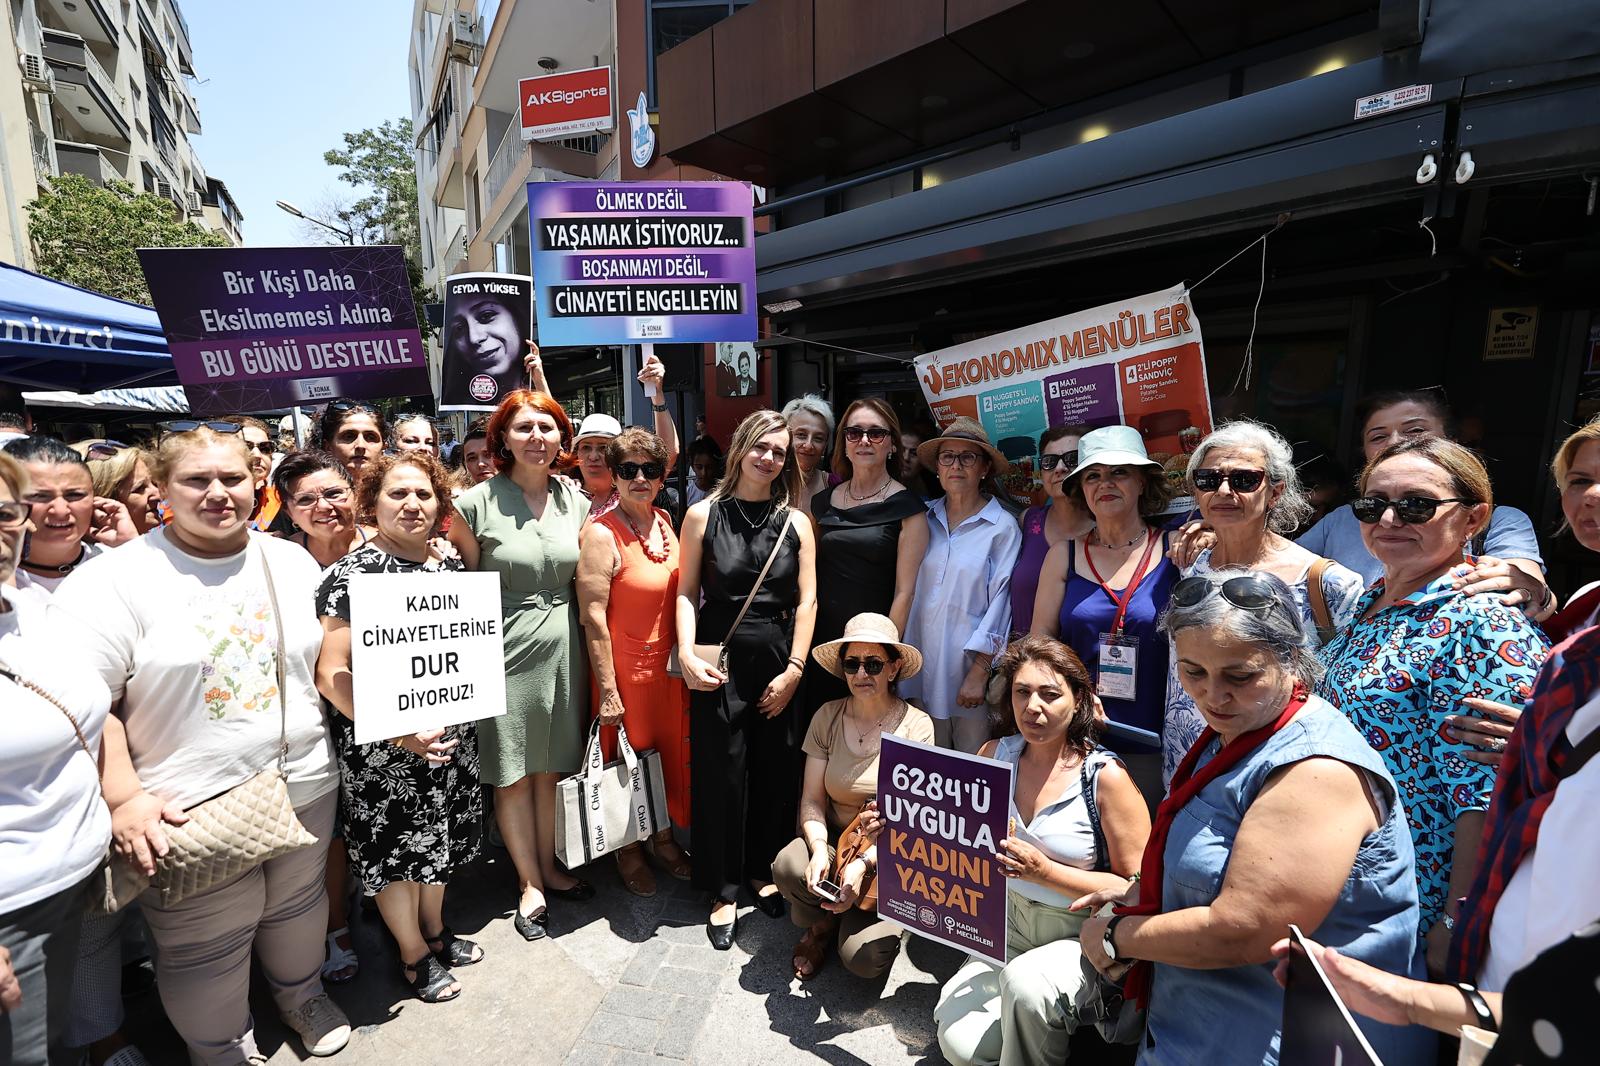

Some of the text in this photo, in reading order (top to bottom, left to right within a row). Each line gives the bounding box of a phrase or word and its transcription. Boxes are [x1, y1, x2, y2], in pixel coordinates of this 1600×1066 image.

[526, 87, 608, 106] AKSigorta
[596, 189, 687, 210] ÖLMEK DEĞİL
[546, 219, 739, 251] YAŞAMAK İSTİYORUZ...
[582, 255, 708, 281] BOŞANMAYI DEĞİL,
[223, 269, 356, 298] Bir Kişi Daha
[452, 282, 520, 295] CEYDA YÜKSEL
[555, 286, 632, 313] CİNAYETİ
[636, 285, 738, 312] ENGELLEYİN
[200, 304, 392, 332] Eksilmemesi Adına
[200, 338, 413, 378] BU GÜNÜ DESTEKLE
[942, 302, 1193, 391] EKONOMIX MENÜLER
[1129, 369, 1135, 380] 4
[1138, 367, 1173, 382] SANDVİÇ
[1152, 356, 1178, 369] POPPY
[1052, 386, 1057, 395] 3
[1061, 383, 1097, 397] EKONOMIX
[986, 400, 991, 409] 2
[993, 401, 1012, 411] POPPY
[407, 594, 458, 612] KADIN
[362, 618, 496, 647] CİNAYETLERİNE
[412, 652, 459, 678] DUR
[398, 683, 474, 711] DİYORUZ!
[630, 767, 640, 792] Chloé
[892, 764, 991, 814] 6284'Ü
[592, 783, 600, 811] Chloé
[637, 805, 648, 832] Chloé
[884, 794, 996, 854] UYGULA
[596, 825, 605, 852] Chloé
[890, 828, 990, 887] KADINI
[896, 864, 984, 917] YAŞAT
[956, 922, 978, 934] KADIN
[956, 929, 994, 948] MECLİSLERİ
